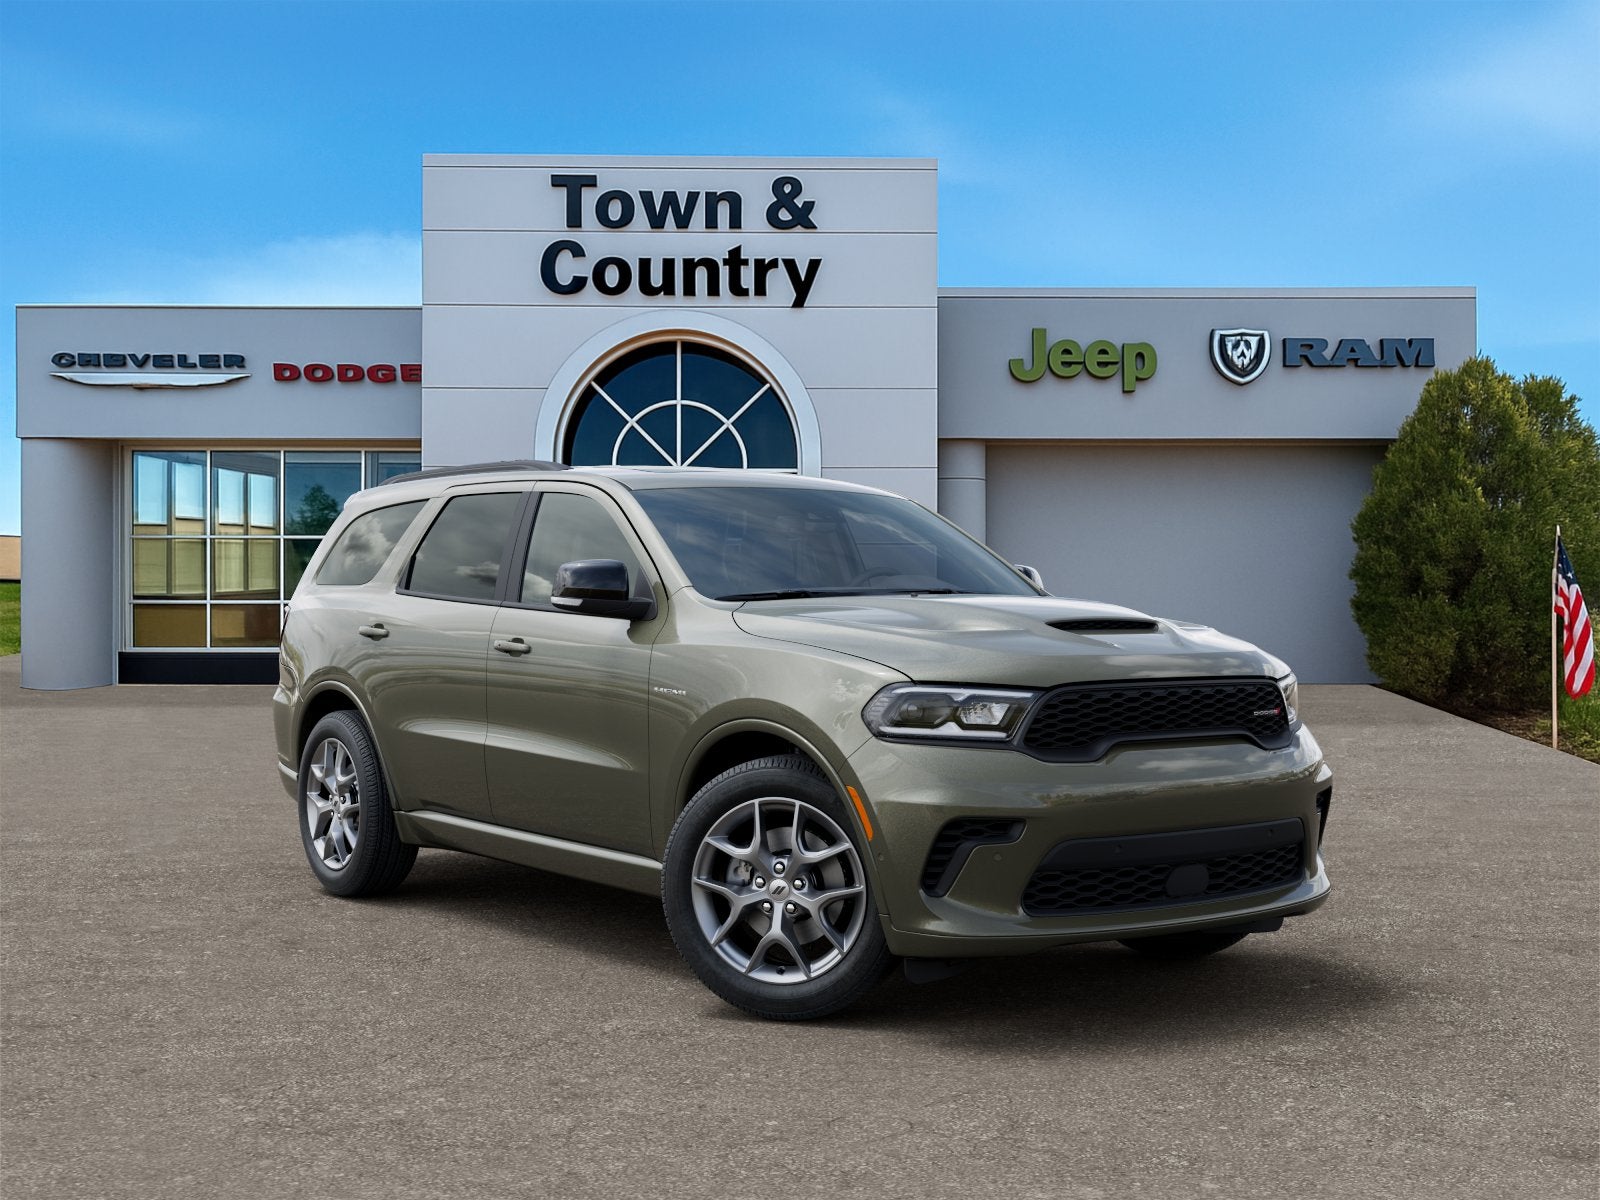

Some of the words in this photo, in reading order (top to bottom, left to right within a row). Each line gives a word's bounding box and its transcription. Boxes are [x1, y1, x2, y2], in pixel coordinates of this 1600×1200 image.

[550, 174, 743, 230] Town
[765, 175, 818, 230] &
[540, 239, 822, 308] Country
[272, 363, 422, 383] DODGE
[1008, 327, 1158, 392] Jeep
[1282, 337, 1435, 368] RAM
